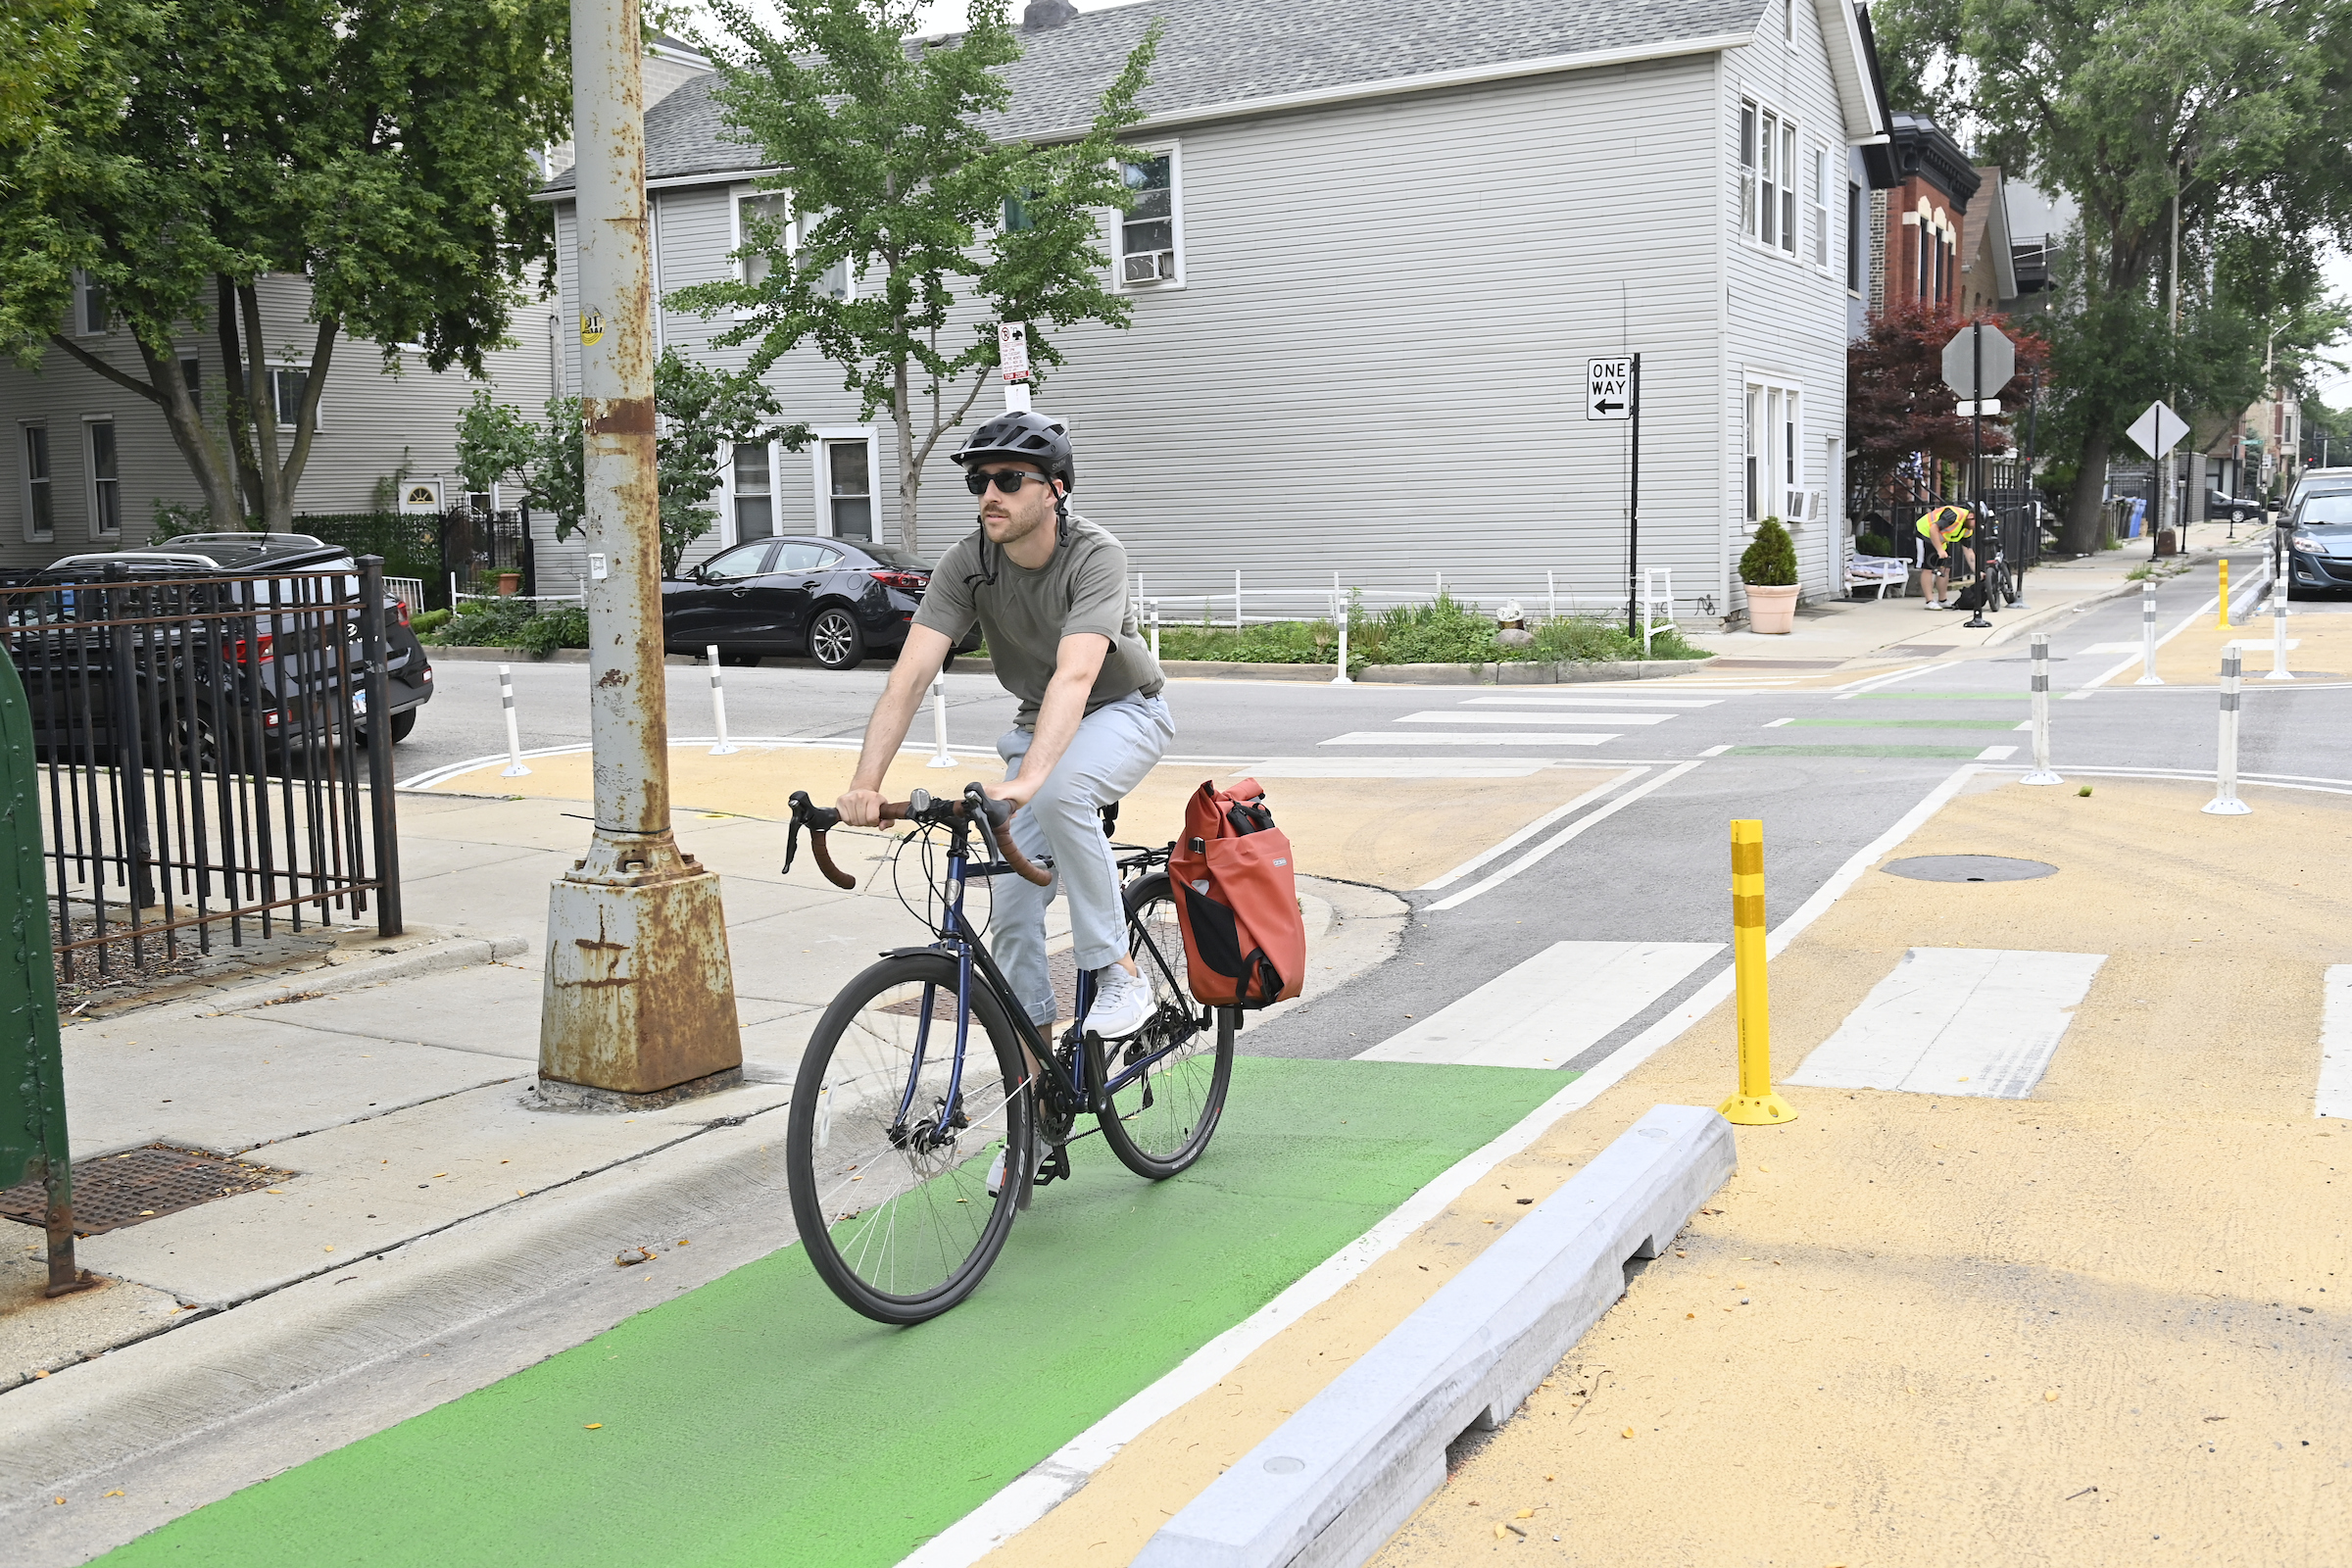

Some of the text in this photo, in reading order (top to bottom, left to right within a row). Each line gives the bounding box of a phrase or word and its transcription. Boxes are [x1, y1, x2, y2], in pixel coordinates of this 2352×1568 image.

[1593, 364, 1626, 378] ONE
[1592, 380, 1626, 395] WAY
[1052, 459, 1066, 470] SMITH
